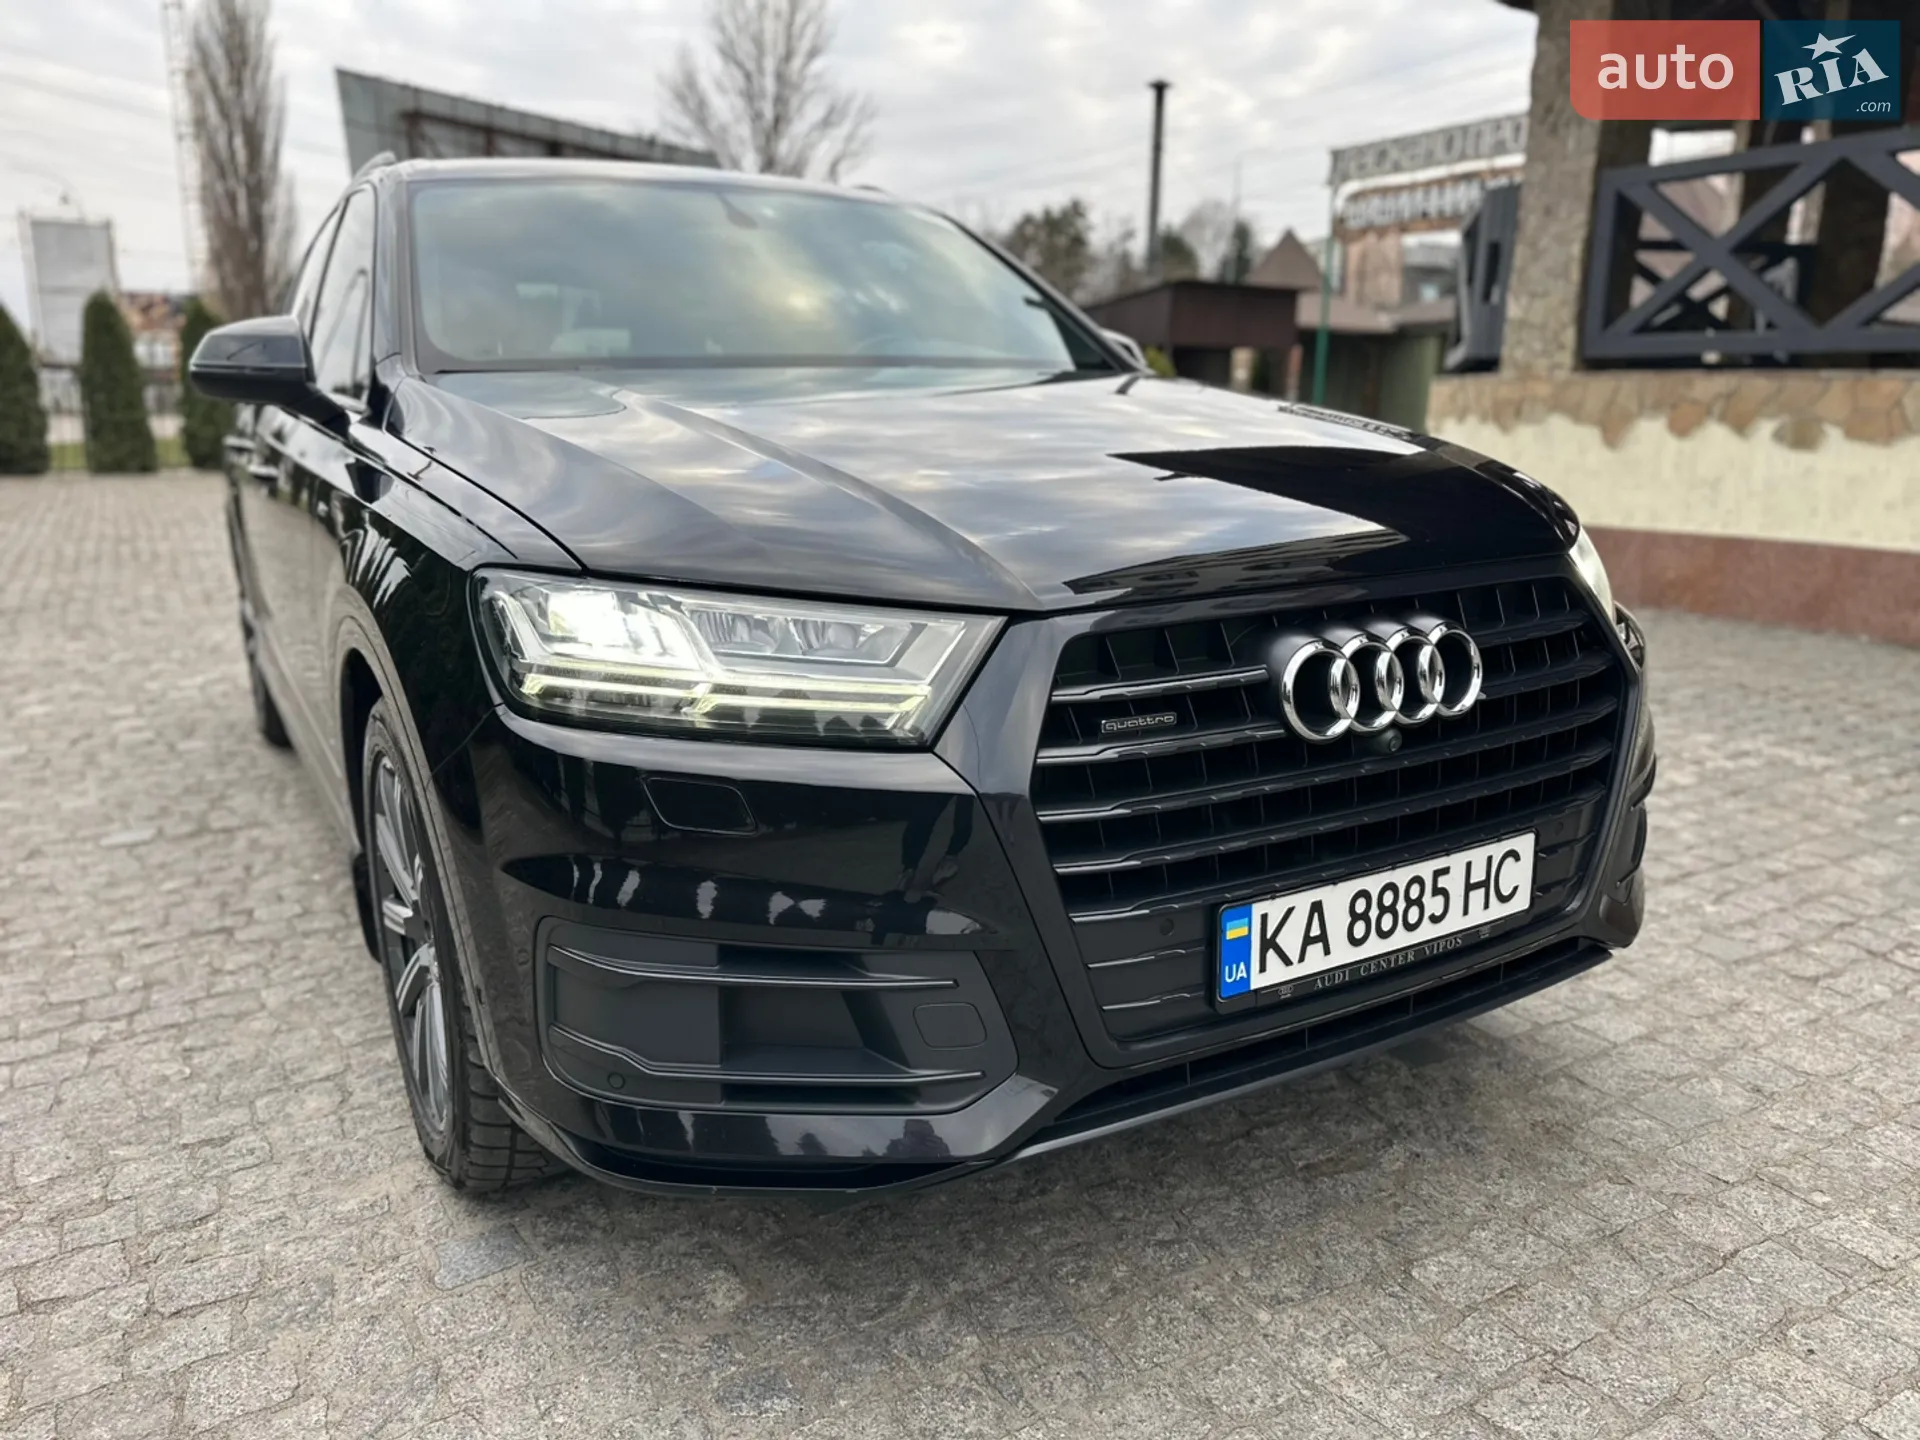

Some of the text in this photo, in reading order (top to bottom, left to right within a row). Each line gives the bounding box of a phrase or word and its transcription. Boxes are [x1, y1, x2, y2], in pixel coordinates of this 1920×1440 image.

[1105, 715, 1175, 731] quattro
[1258, 848, 1521, 974] KA 8885 HC
[1225, 963, 1247, 983] UA
[1314, 935, 1463, 990] AUDI CENTER VIPOS
